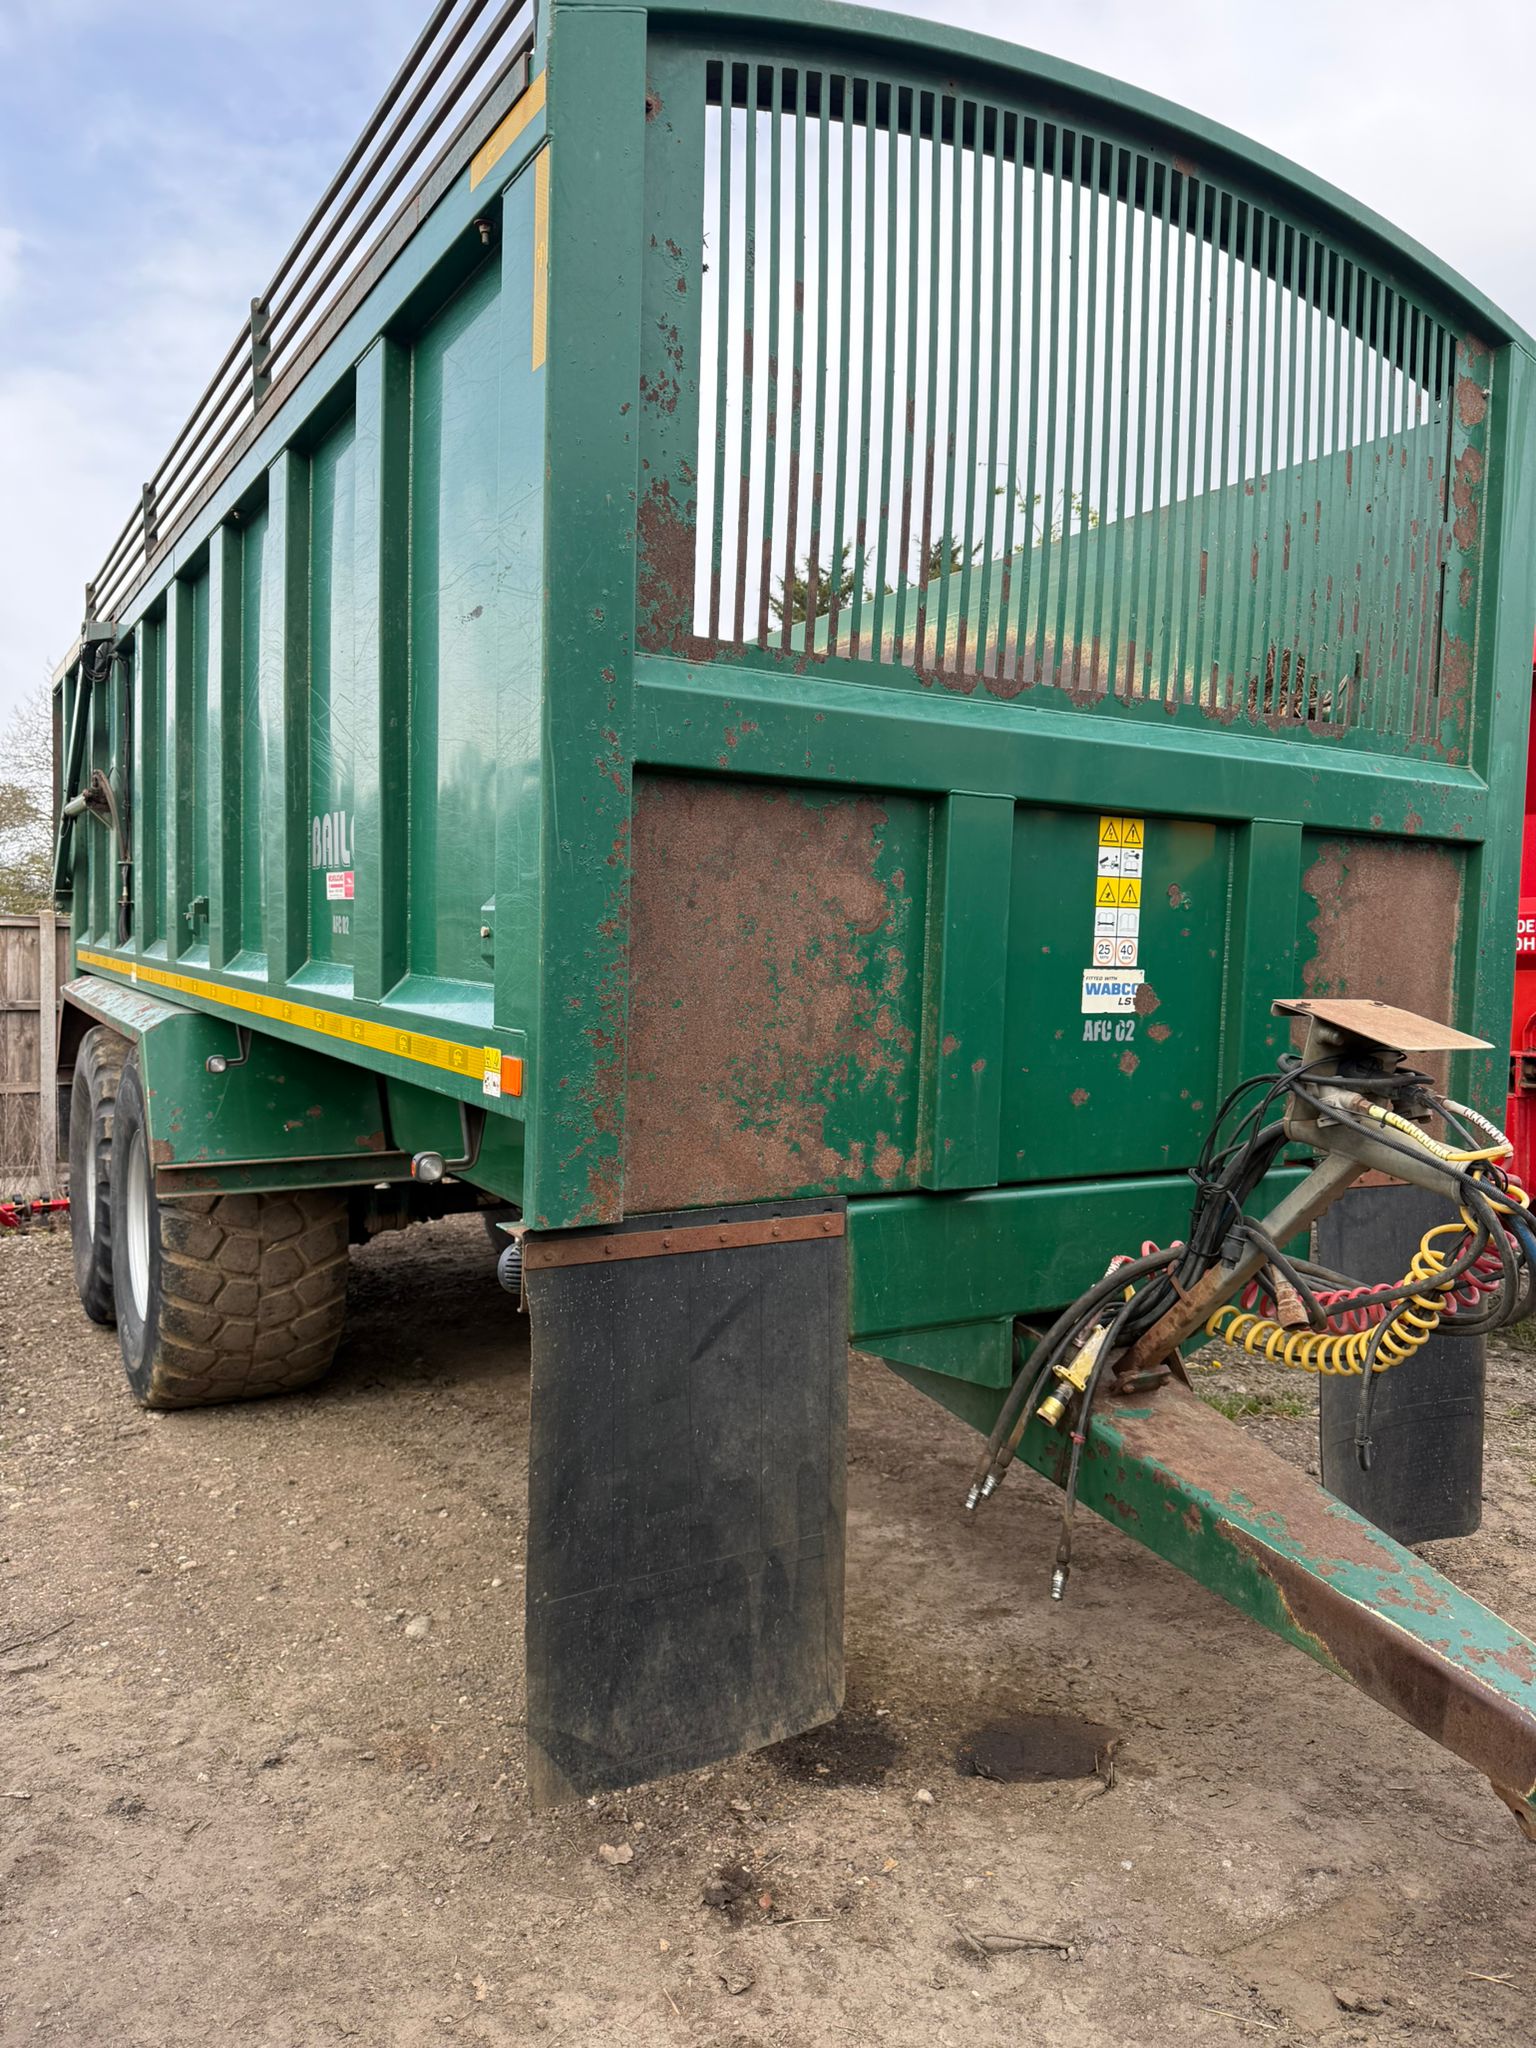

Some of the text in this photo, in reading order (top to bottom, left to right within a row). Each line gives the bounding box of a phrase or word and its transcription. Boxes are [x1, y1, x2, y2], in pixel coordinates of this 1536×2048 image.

[1098, 943, 1111, 955] 25
[1120, 944, 1134, 956] 40
[1082, 1019, 1112, 1042] AFC
